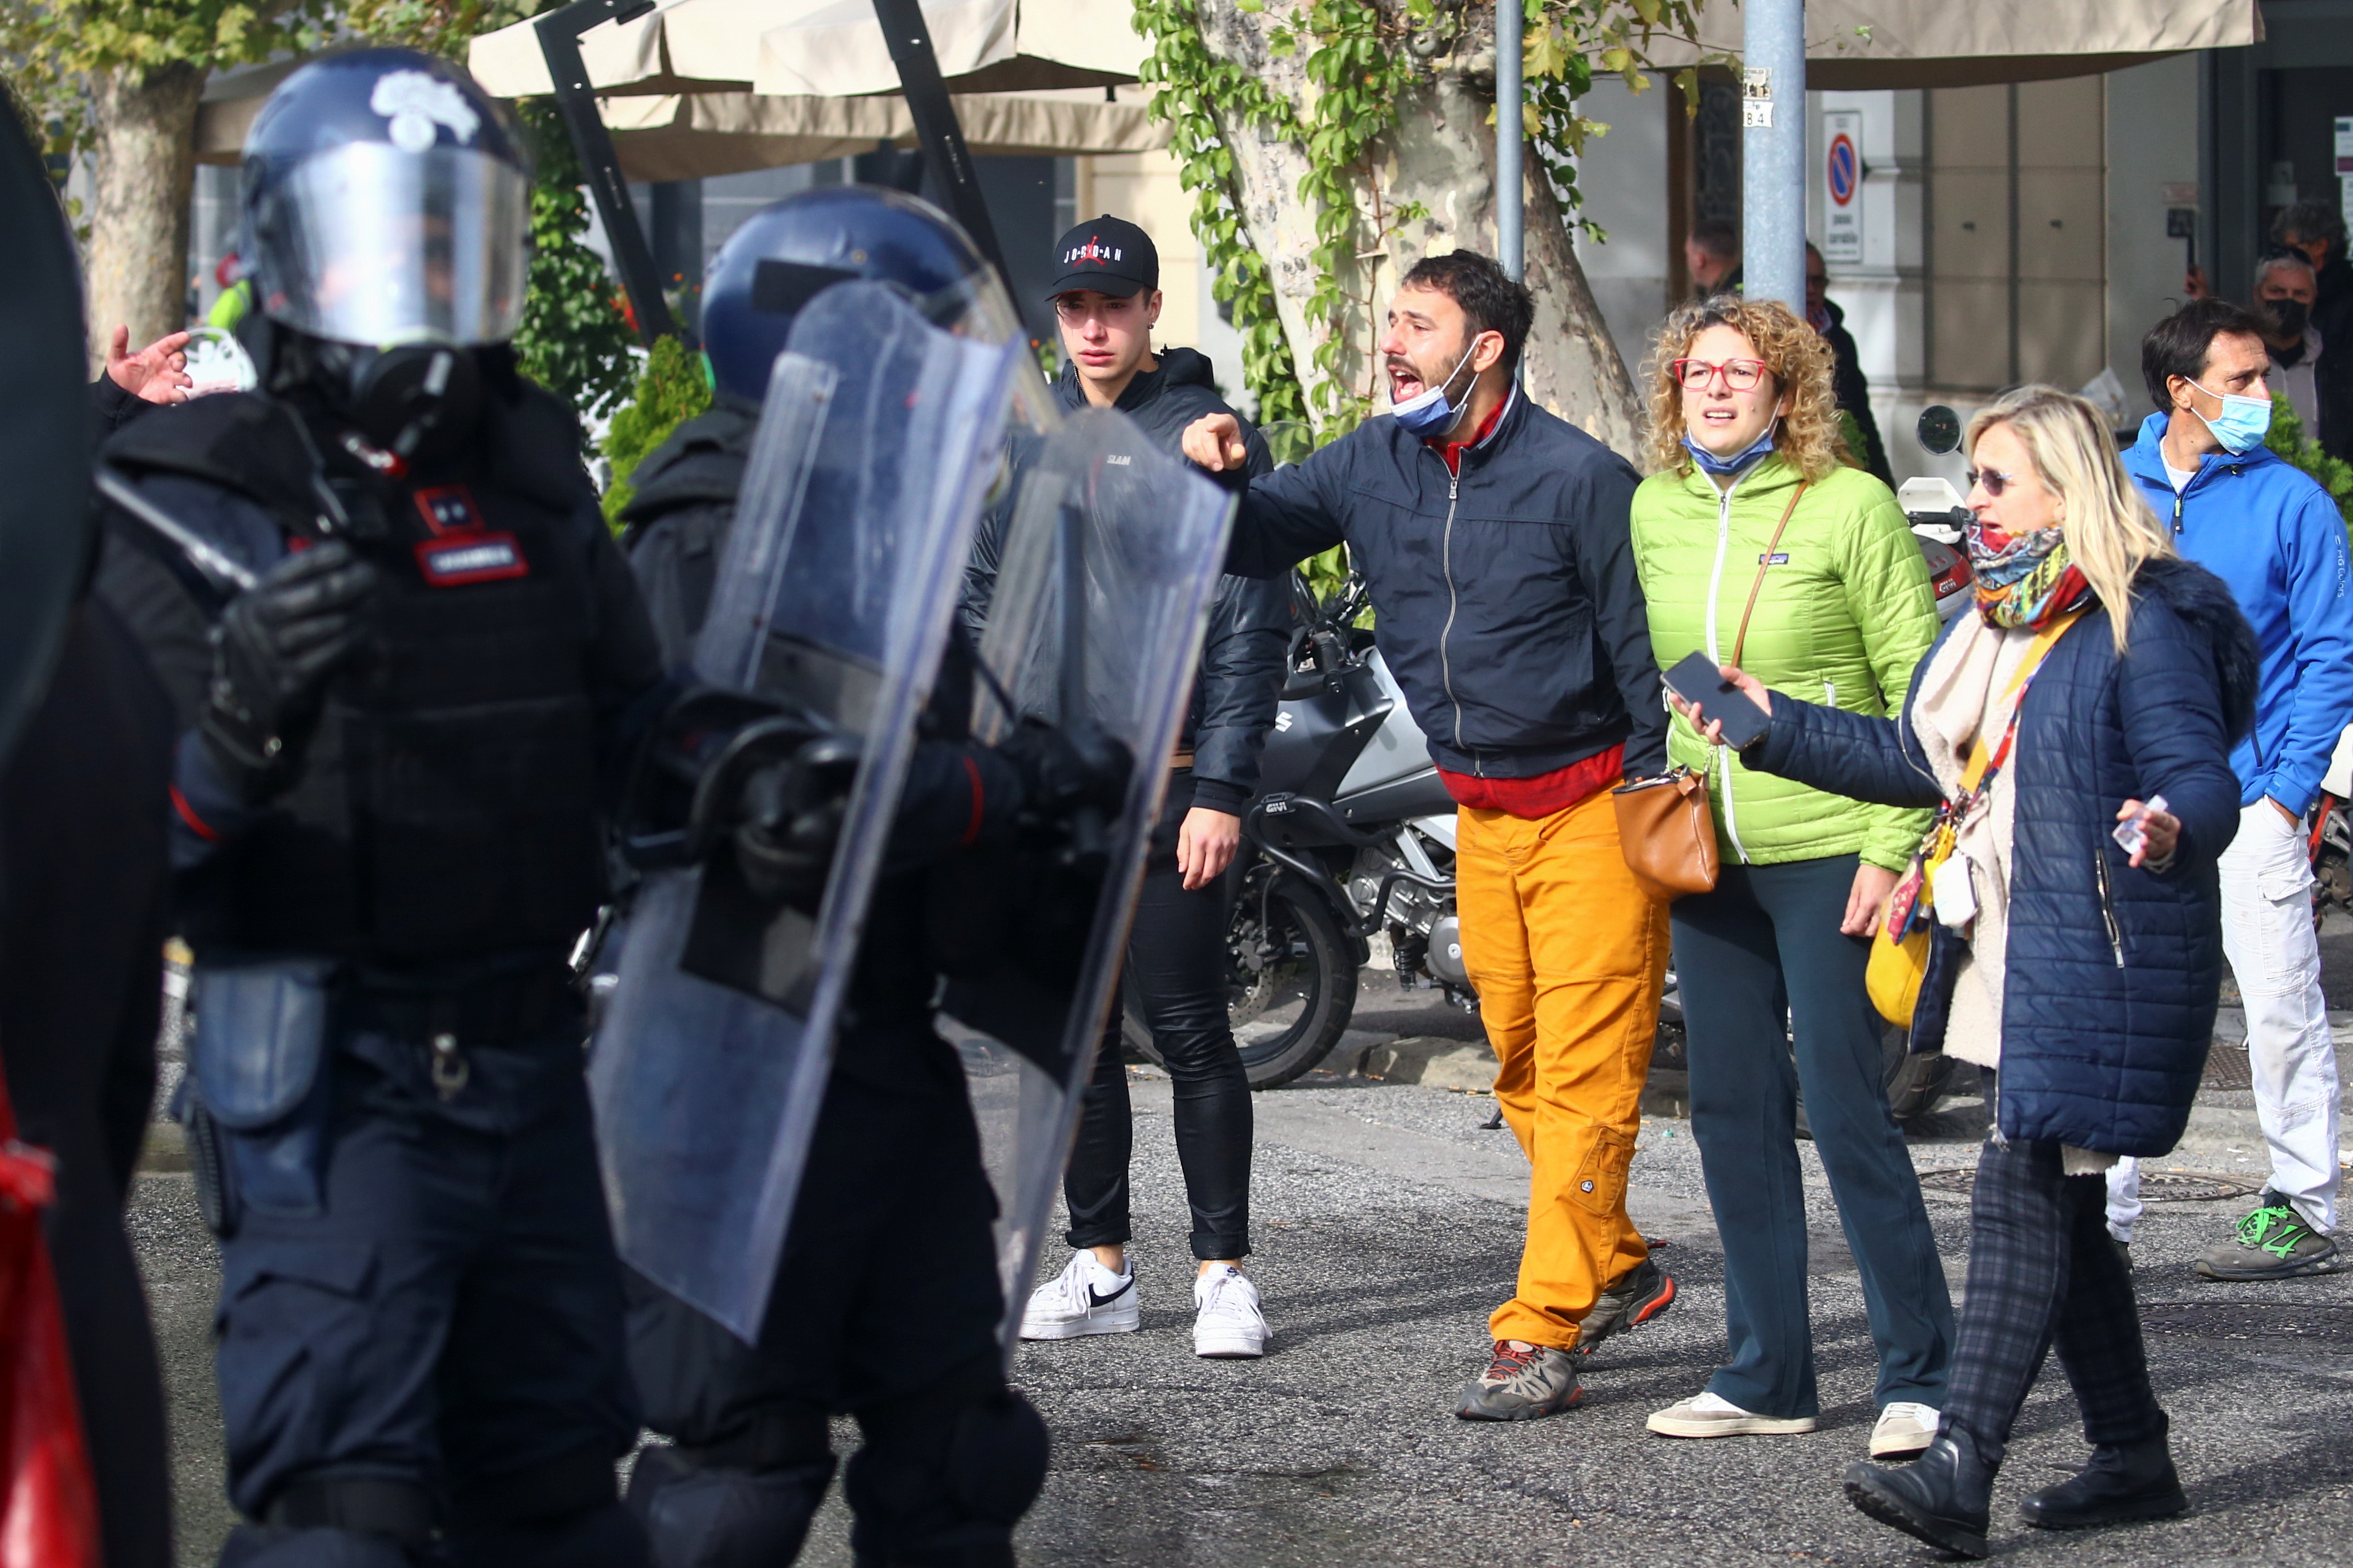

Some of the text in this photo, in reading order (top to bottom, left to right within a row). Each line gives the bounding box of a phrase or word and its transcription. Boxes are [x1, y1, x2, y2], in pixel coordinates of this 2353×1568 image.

[1063, 245, 1122, 263] JORDAN
[1107, 454, 1131, 466] SLAM
[2337, 549, 2345, 566] MG
[1266, 801, 1288, 813] GIVI
